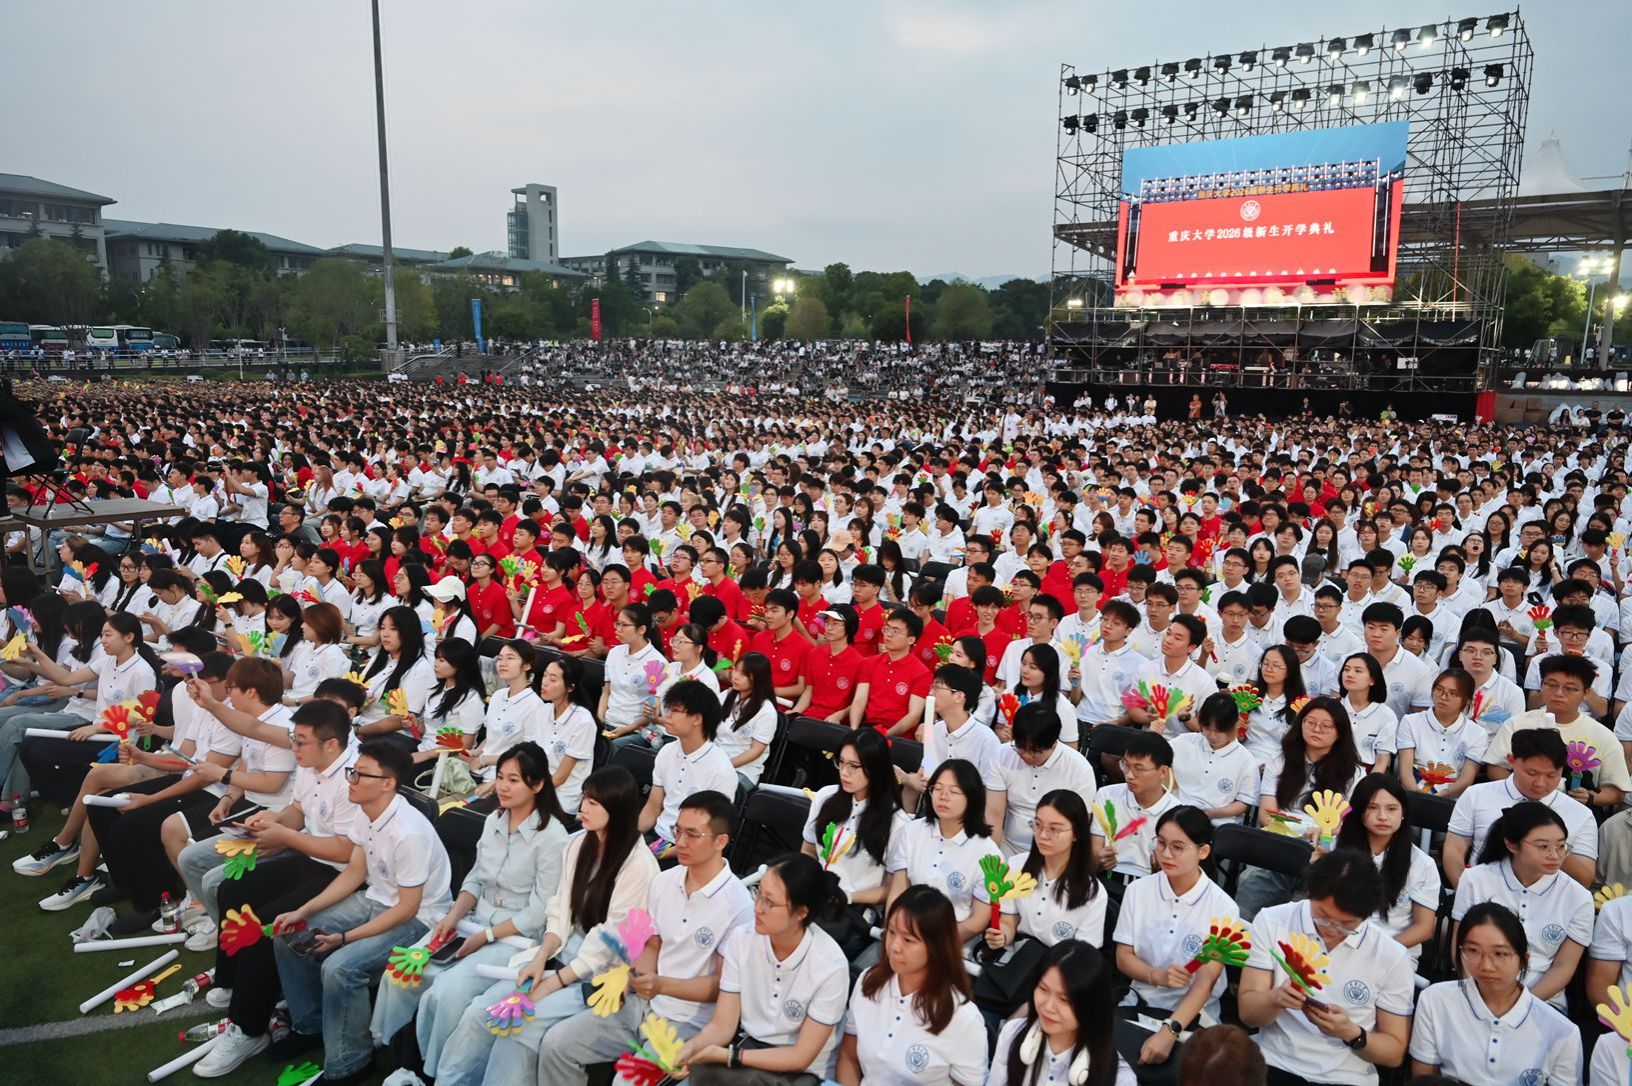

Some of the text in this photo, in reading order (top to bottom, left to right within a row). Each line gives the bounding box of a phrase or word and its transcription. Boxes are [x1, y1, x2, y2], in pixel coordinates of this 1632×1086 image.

[1168, 222, 1334, 242] 重庆大学2026级新生开学典礼
